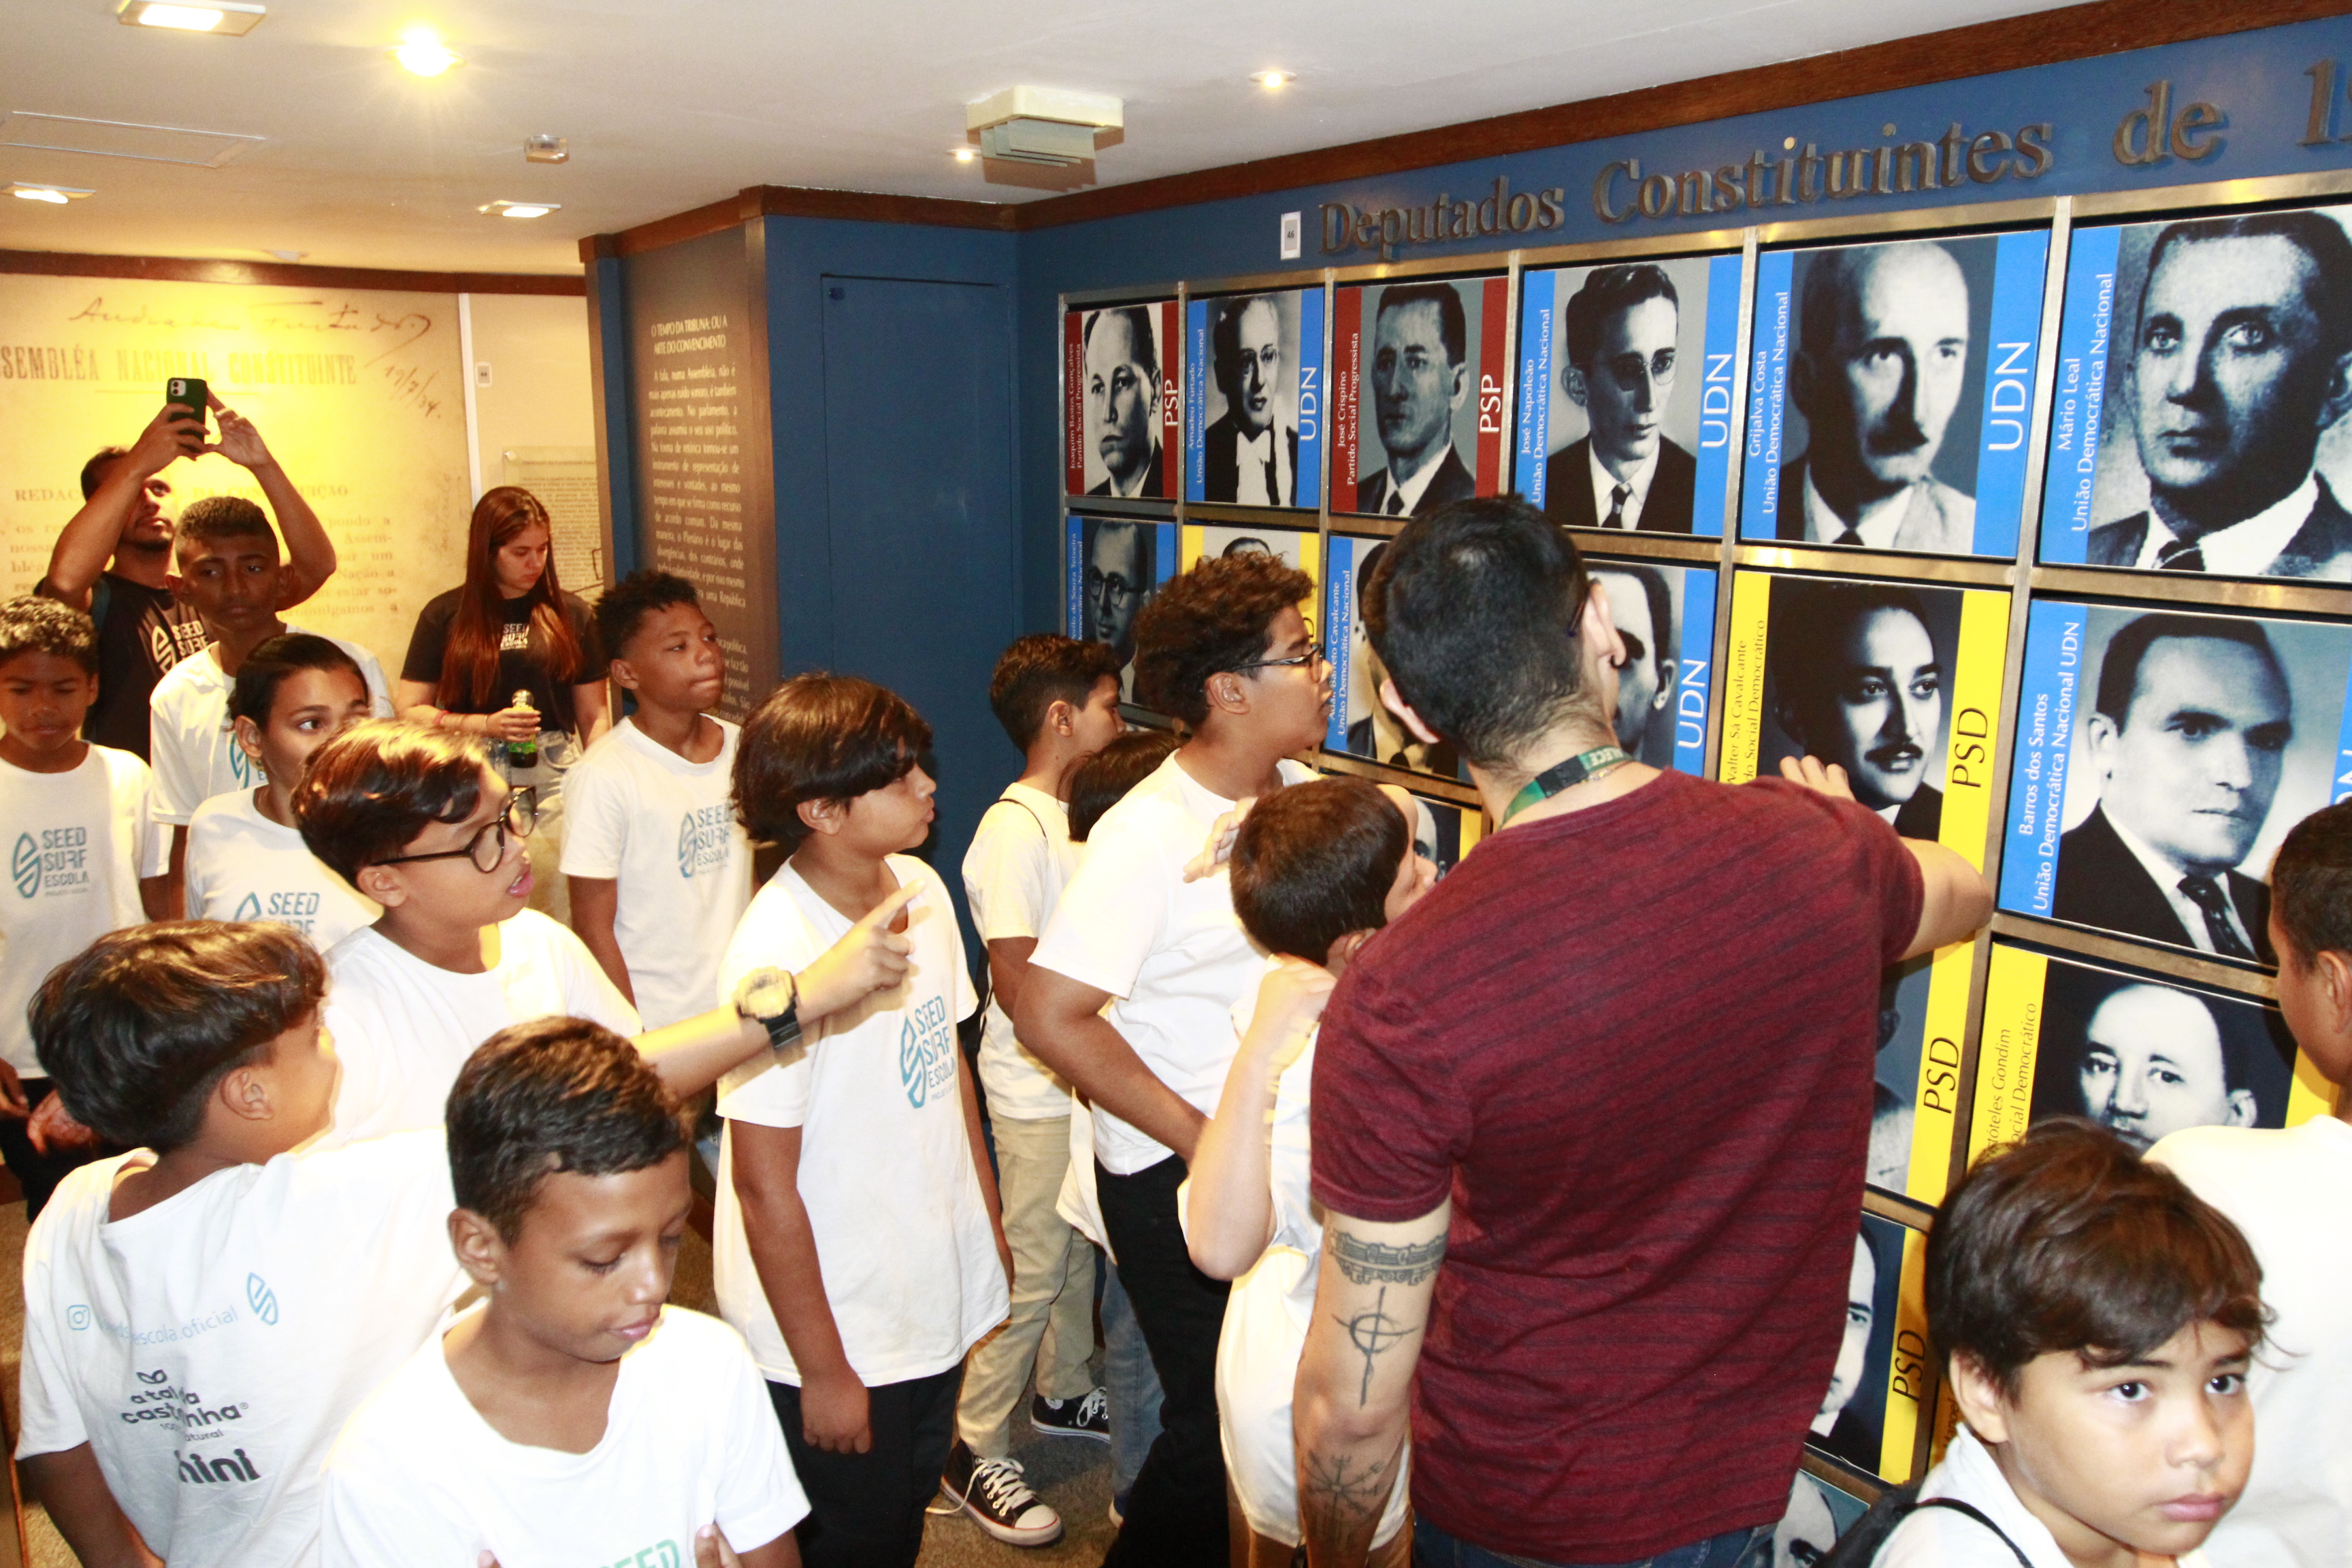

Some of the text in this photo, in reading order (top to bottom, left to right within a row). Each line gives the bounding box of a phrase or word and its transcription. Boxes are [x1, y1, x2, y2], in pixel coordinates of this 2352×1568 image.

[1319, 175, 1565, 263] Deputados
[1592, 122, 2054, 223] Constituintes
[2113, 80, 2225, 165] de
[1287, 229, 1295, 240] 46
[228, 352, 357, 385] CONSTITUINTE
[1075, 343, 1083, 410] Progressista
[1164, 378, 1179, 427] PSP
[1299, 366, 1318, 441] UDN
[1479, 374, 1502, 433] PSP
[1701, 353, 1733, 448] UDN
[1748, 350, 1767, 459] Grijalva Costa
[1763, 291, 1789, 514] União Democrática Nacional
[1987, 341, 2031, 451] UDN
[2056, 357, 2081, 451] Mário Leal
[2070, 273, 2114, 533] União Democrática Nacional
[1196, 379, 1204, 450] Democrática
[1337, 371, 1348, 448] José Crispino
[1347, 332, 1360, 485] Partido Social Progressista
[1520, 358, 1535, 455] José Napoleão
[1531, 308, 1551, 504] União Democrática Nacional
[171, 620, 205, 641] SEED
[1330, 581, 1340, 645] Cavalcante
[1337, 570, 1352, 736] União Democrática Nacional
[1731, 640, 1747, 719] Cavalcante
[1748, 619, 1765, 713] Democrático
[1677, 658, 1708, 749] UDN
[1729, 722, 1741, 739] Sá
[1745, 717, 1758, 760] Social
[1951, 707, 1989, 789] PSD
[2019, 693, 2049, 836] Barros dos Santos
[2033, 621, 2080, 912] União Democrática Nacional UDN
[42, 826, 86, 849] SEED
[44, 849, 88, 872] SURF
[697, 825, 731, 850] SURF
[44, 870, 90, 888] ESCOLA
[267, 892, 321, 916] SEED
[914, 994, 946, 1036] SEED
[922, 1025, 951, 1066] SURF
[928, 1056, 957, 1089] ESCOLA
[1923, 1036, 1960, 1115] PSD
[1991, 1028, 2012, 1091] Gondim
[2010, 1002, 2037, 1143] ocial Democrático
[1893, 1329, 1927, 1403] PSD
[184, 1428, 225, 1442] atural
